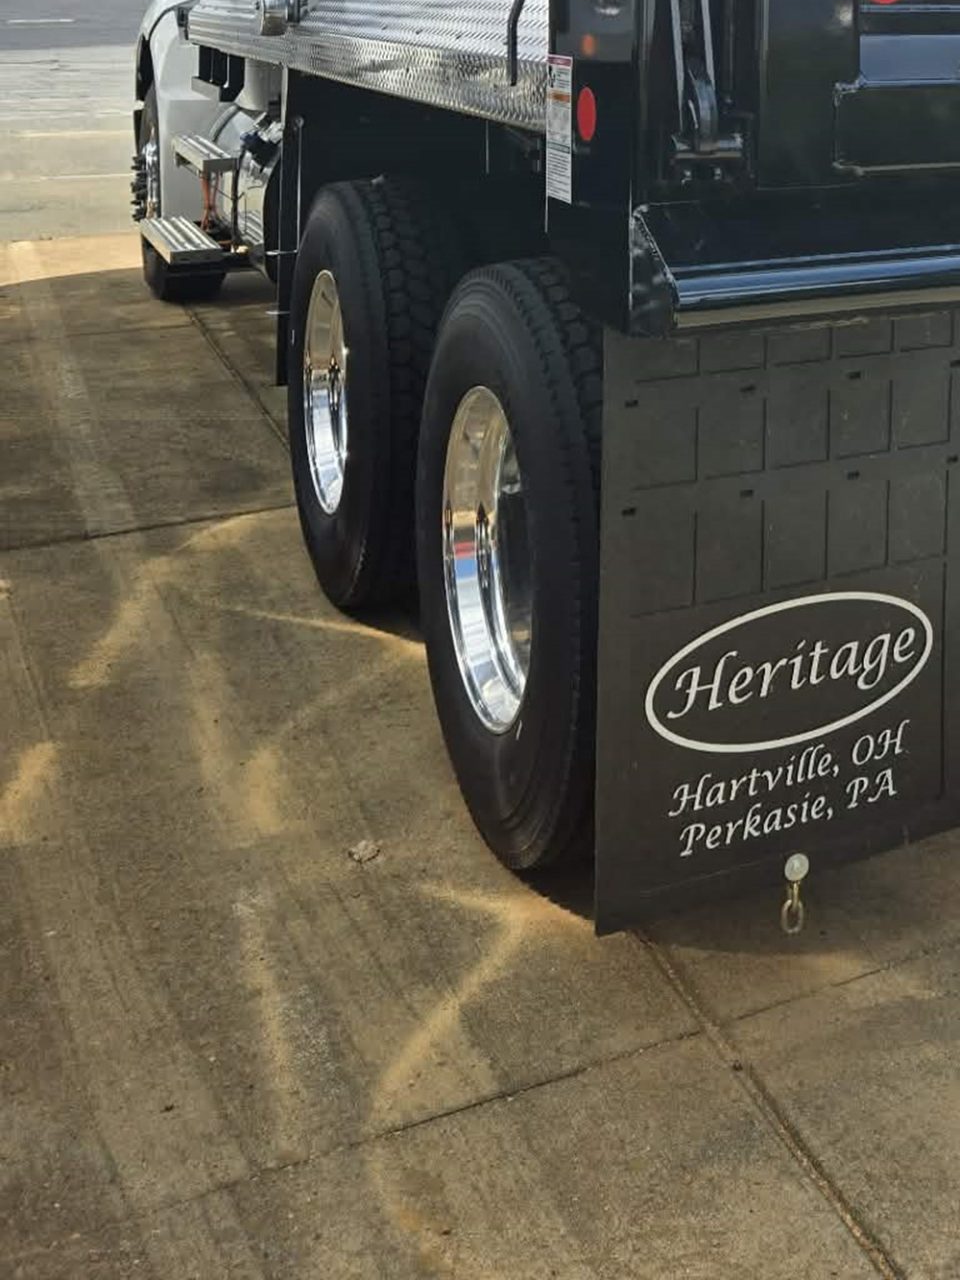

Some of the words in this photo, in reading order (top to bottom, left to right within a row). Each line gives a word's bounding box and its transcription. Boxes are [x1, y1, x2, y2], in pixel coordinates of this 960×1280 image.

[667, 627, 916, 719] Heritage
[668, 742, 840, 817] Hartville,
[851, 720, 911, 766] OH
[680, 791, 834, 857] Perkasie,
[845, 768, 897, 810] PA
